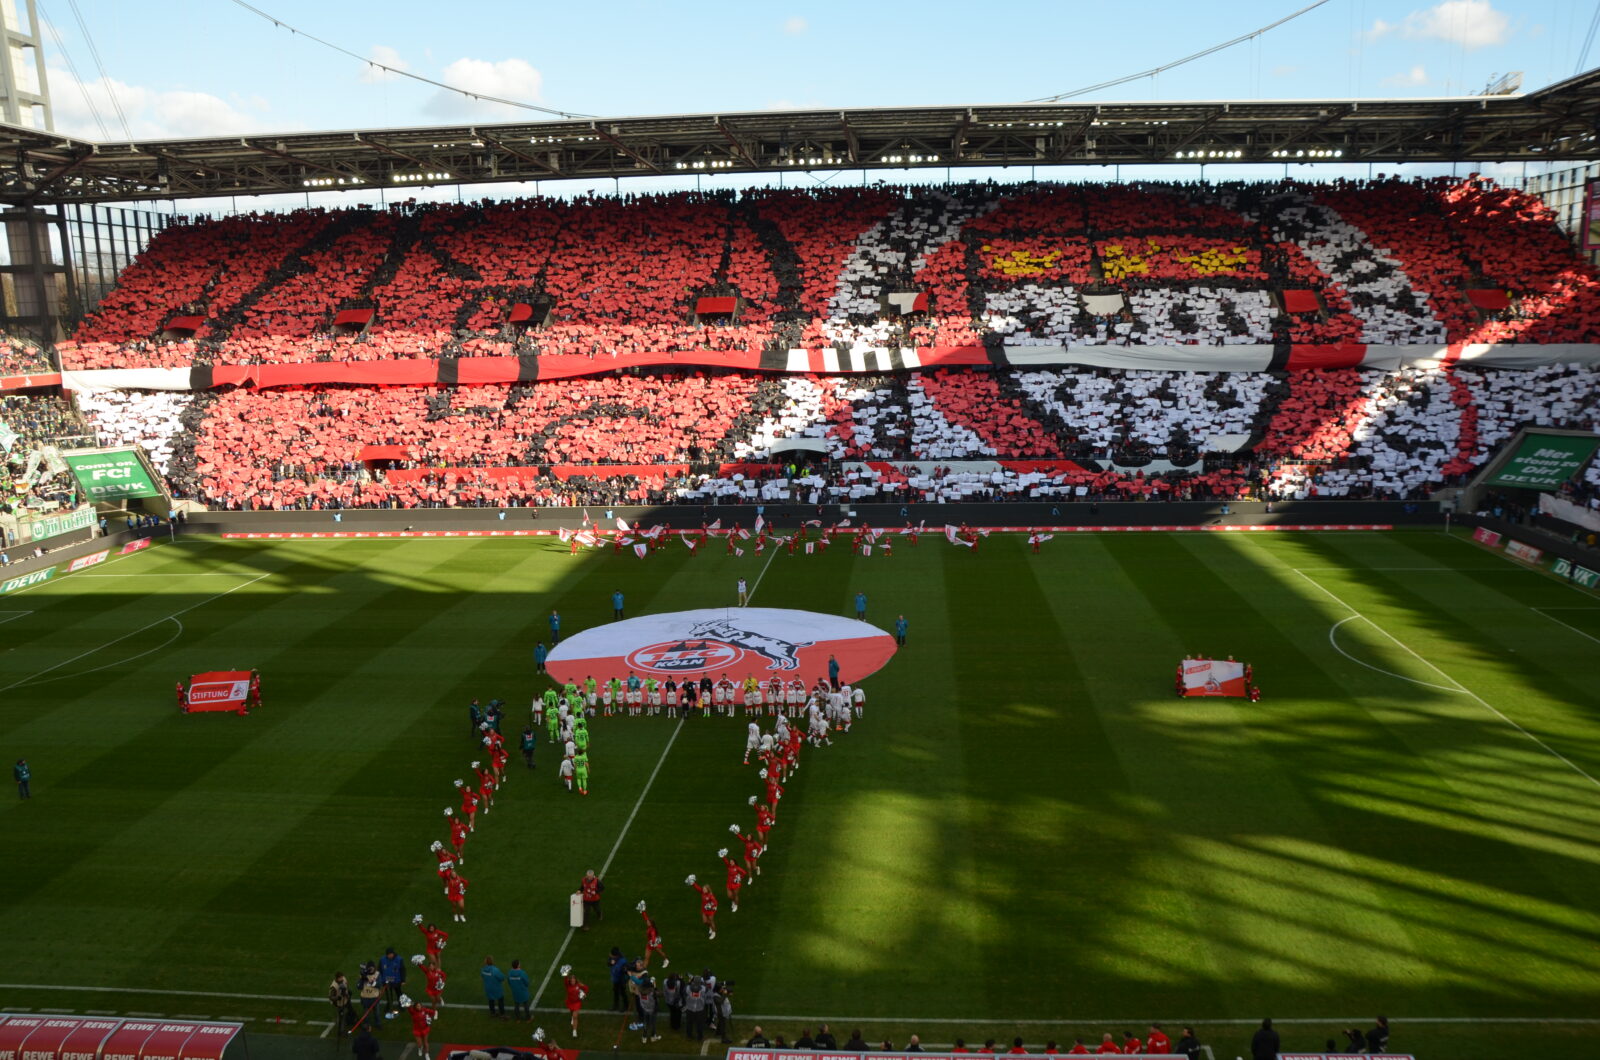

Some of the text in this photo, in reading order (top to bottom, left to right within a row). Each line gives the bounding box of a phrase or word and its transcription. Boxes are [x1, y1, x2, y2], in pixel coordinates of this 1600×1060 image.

[1534, 448, 1573, 458] Mer
[1514, 457, 1559, 466] stonn
[75, 463, 114, 471] Come
[1521, 466, 1561, 475] Dir!
[92, 467, 131, 480] FC!
[1500, 475, 1559, 484] DEVK
[91, 482, 146, 494] DEVK
[6, 569, 50, 591] DEVK
[653, 658, 705, 668] KÖLN
[192, 690, 228, 699] STIFTUNG
[6, 1019, 41, 1027] REWE
[44, 1020, 79, 1028] REWE
[122, 1023, 156, 1031] REWE
[160, 1025, 194, 1033] REWE
[200, 1026, 233, 1034] REWE
[0, 1050, 15, 1060] WE
[23, 1051, 54, 1060] REWE
[62, 1052, 94, 1060] REWE
